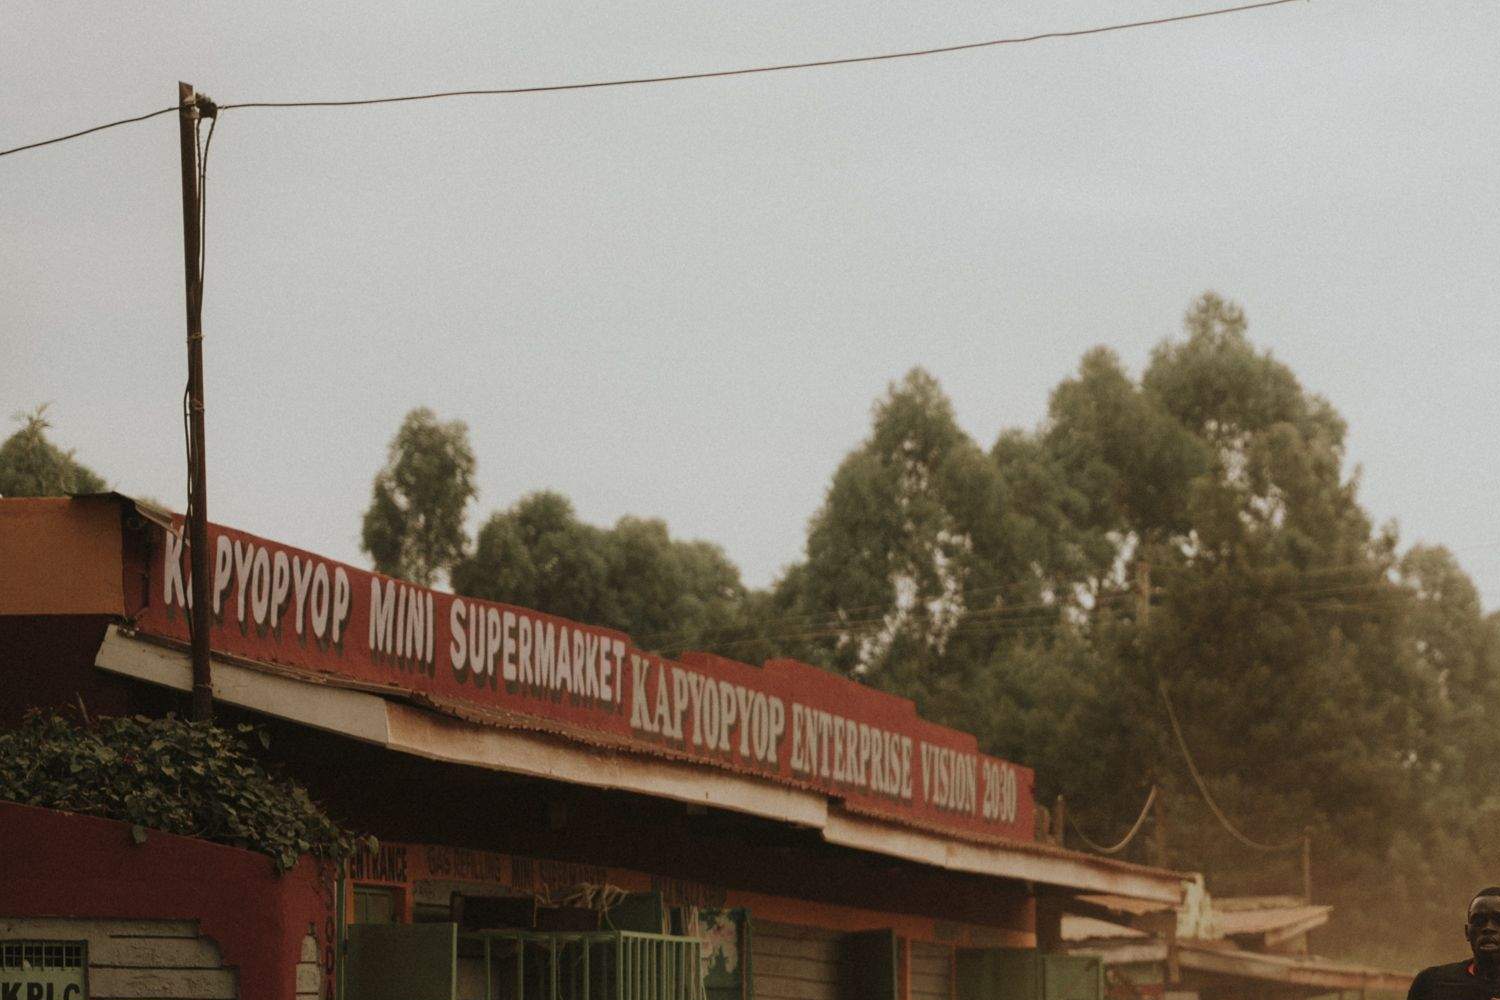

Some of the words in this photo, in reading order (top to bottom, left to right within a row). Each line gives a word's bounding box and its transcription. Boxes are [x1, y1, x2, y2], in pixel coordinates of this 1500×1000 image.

[164, 523, 350, 643] KPYOPYOP
[369, 576, 434, 664] MINI
[451, 598, 626, 704] SUPERMARKET
[630, 655, 785, 764] KAPYOPYOP
[790, 703, 913, 799] ENTERPRISE
[920, 741, 978, 813] VISION
[983, 762, 1017, 823] 2030
